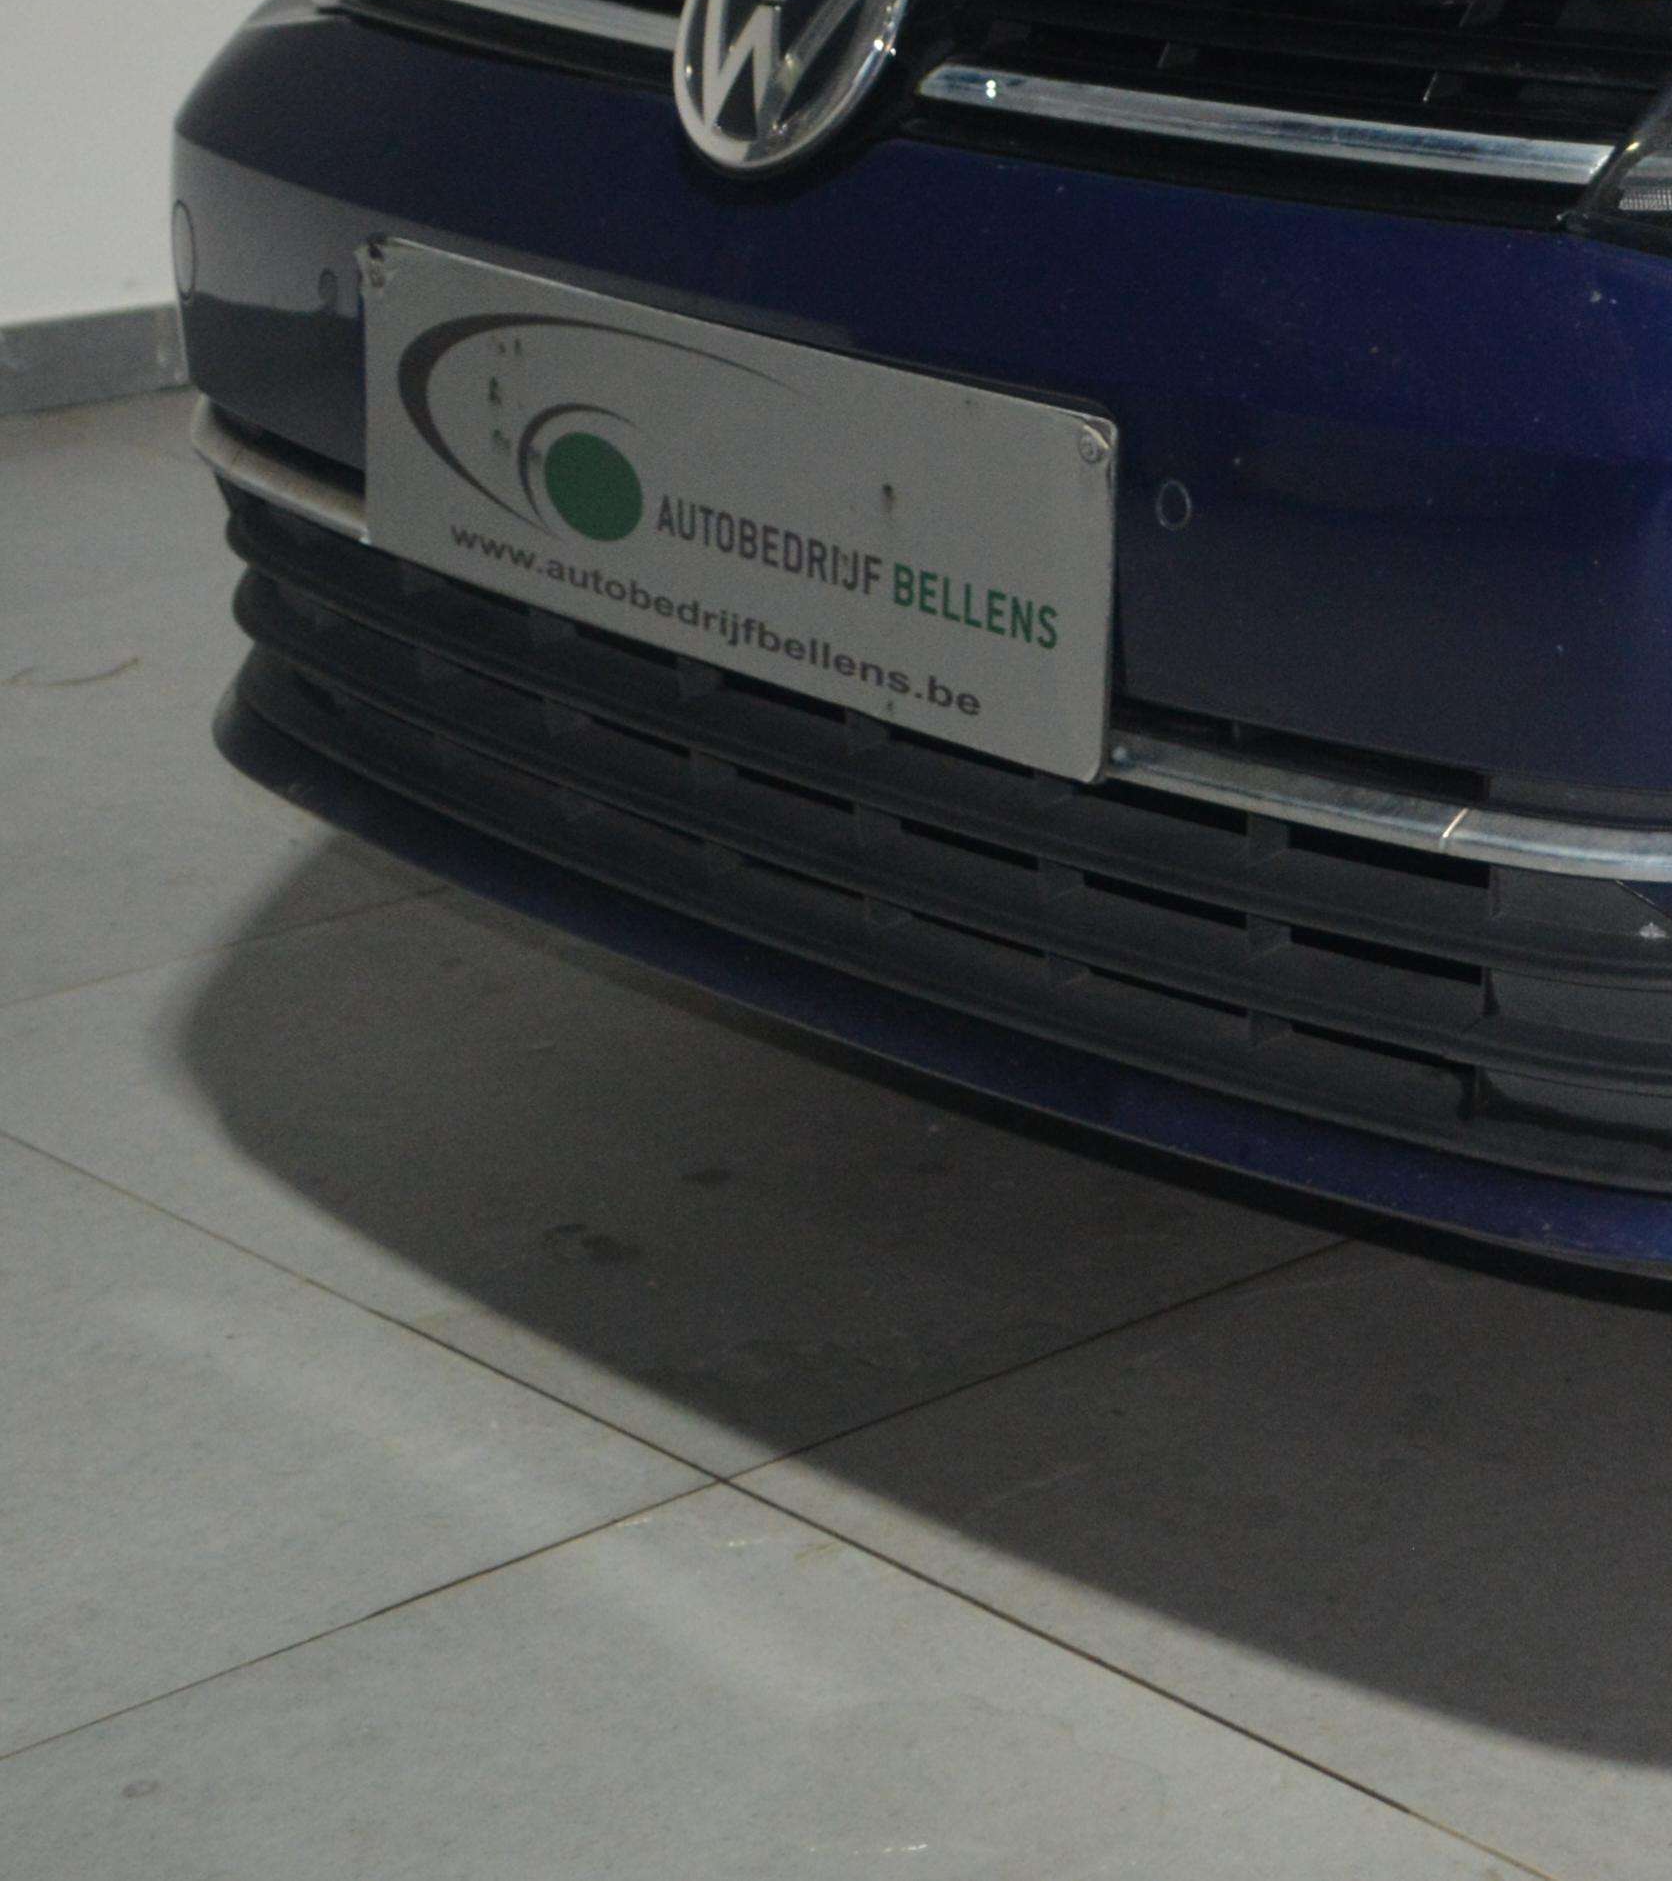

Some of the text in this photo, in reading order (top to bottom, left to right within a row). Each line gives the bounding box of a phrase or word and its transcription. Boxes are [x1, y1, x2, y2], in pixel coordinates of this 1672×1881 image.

[449, 522, 983, 718] www.autobedrijfbellens.be
[655, 493, 1059, 651] AUTOBEDRIJF BELLENS
